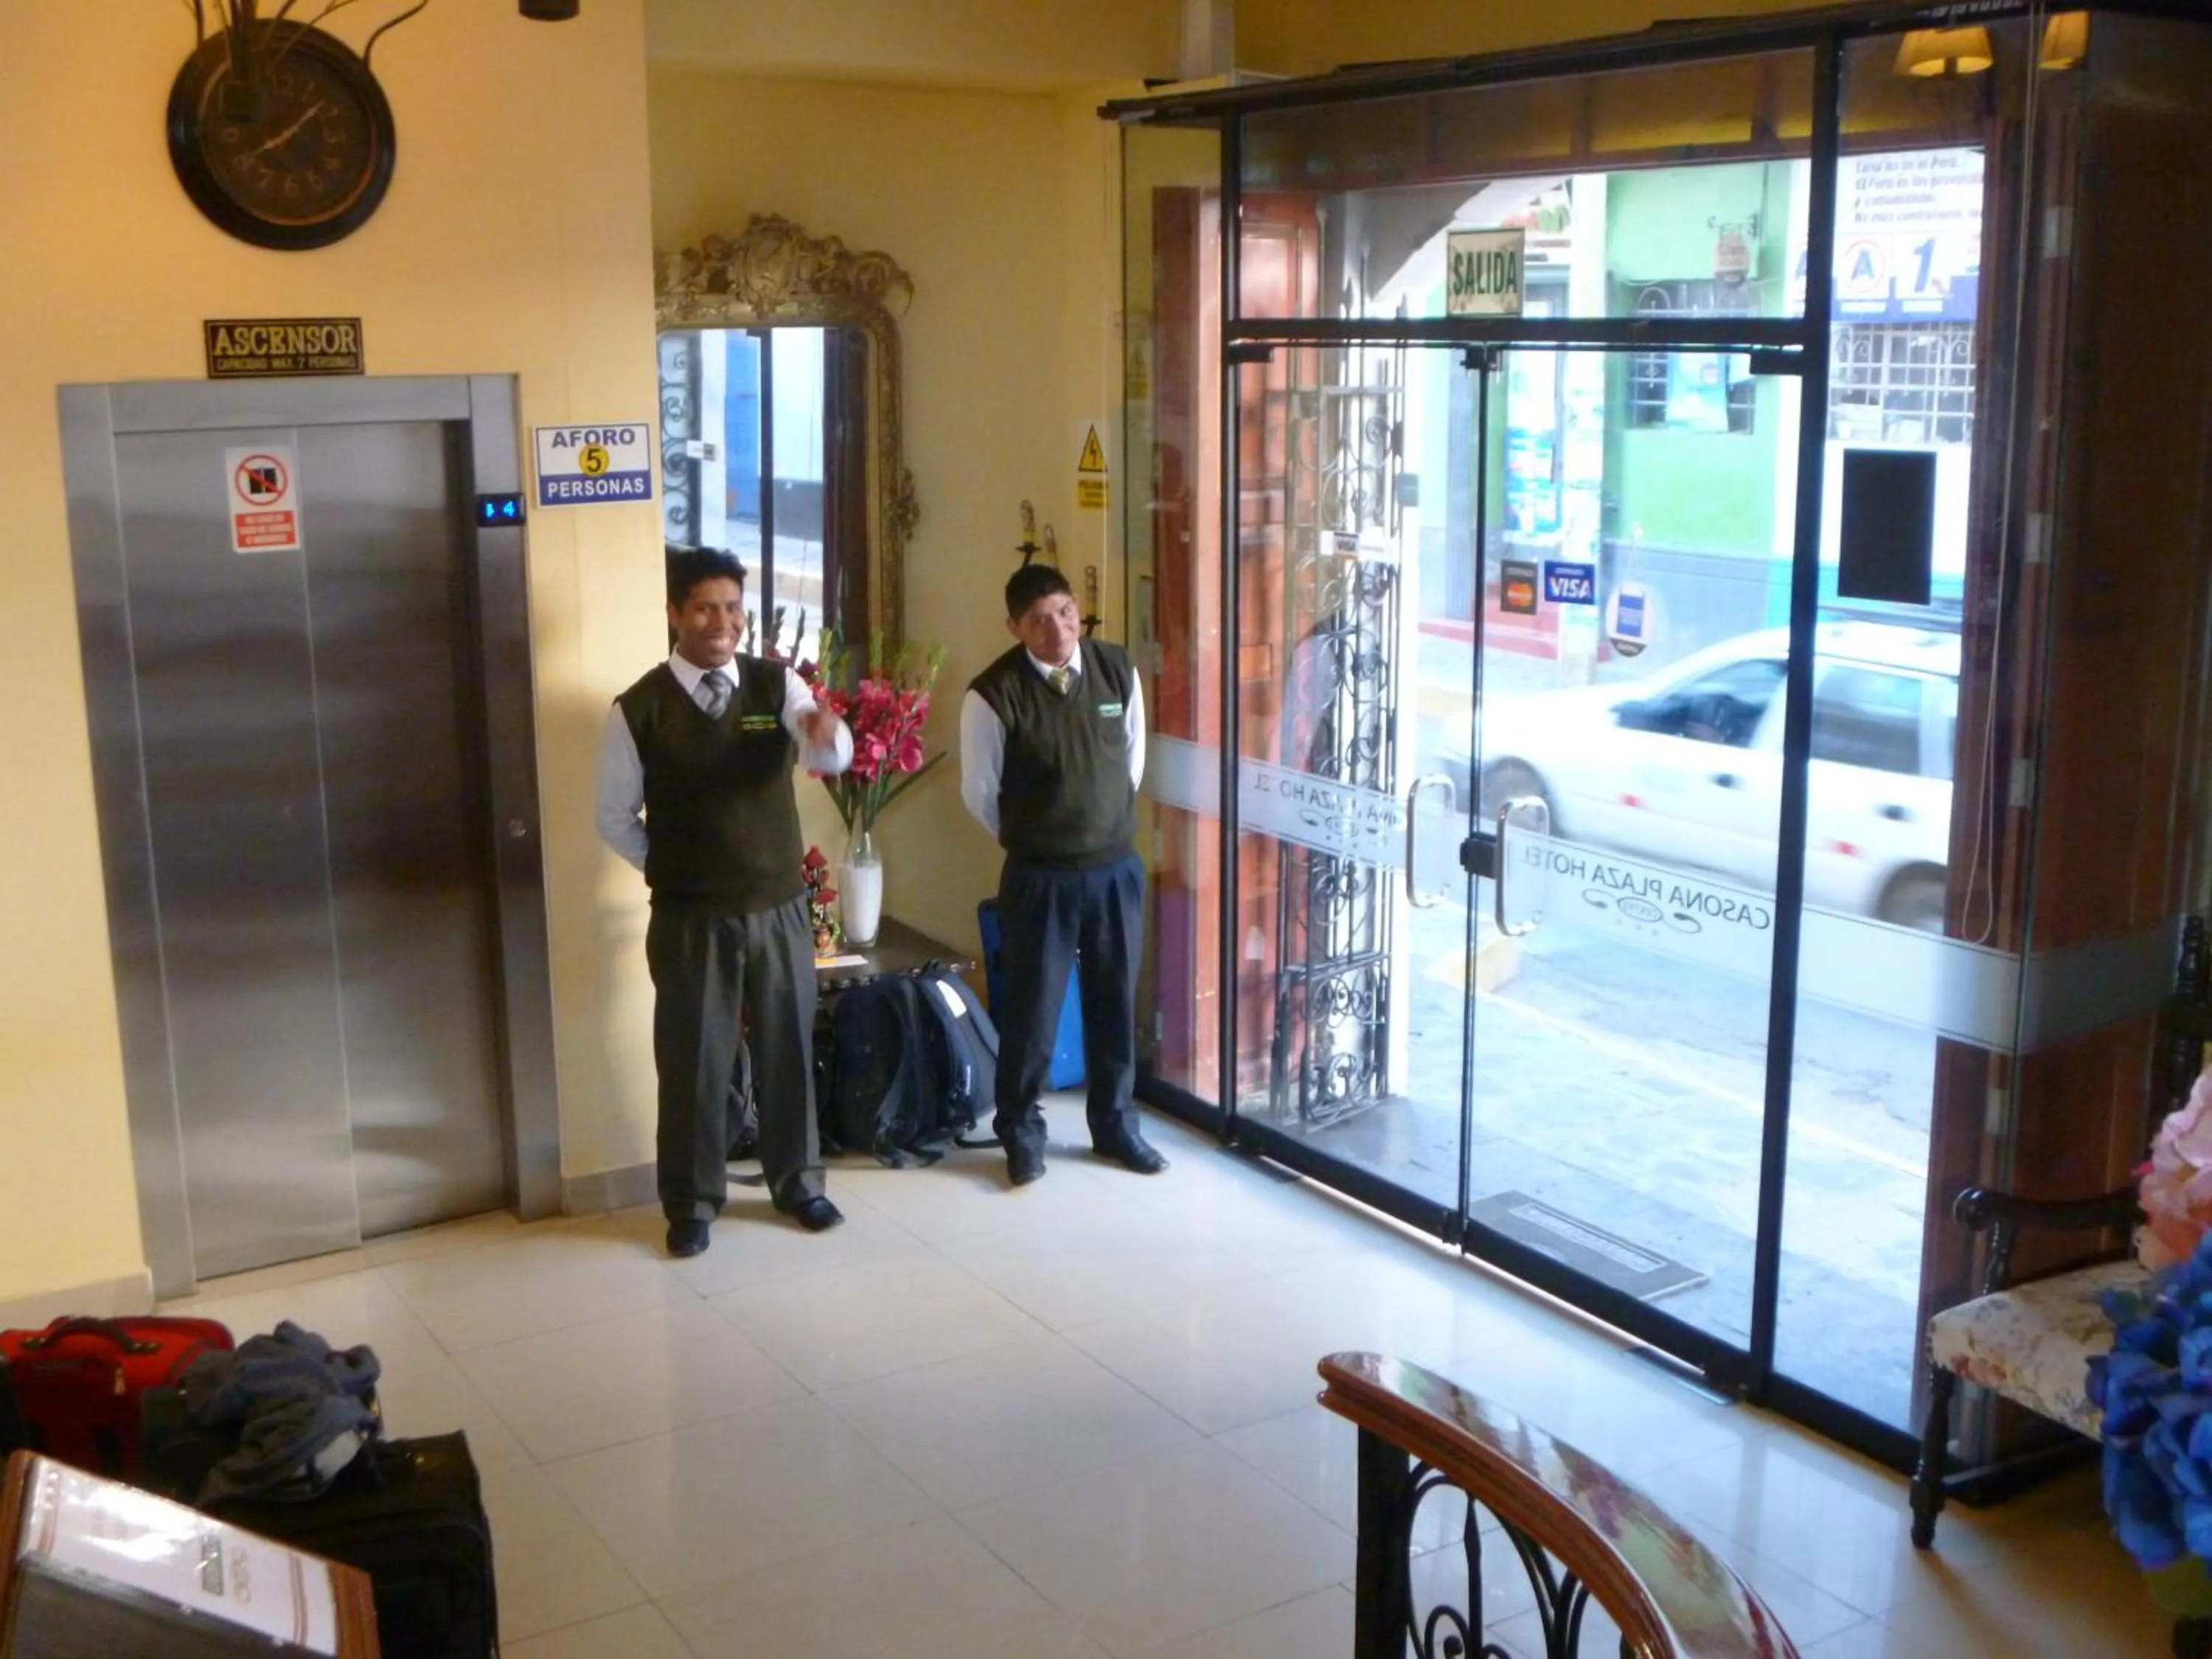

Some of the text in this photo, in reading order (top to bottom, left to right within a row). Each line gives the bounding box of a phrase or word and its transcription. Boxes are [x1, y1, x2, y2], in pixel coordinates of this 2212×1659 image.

[1453, 251, 1518, 296] SALIDA
[1851, 249, 1875, 282] A
[1913, 237, 1936, 293] 1
[214, 324, 358, 356] ASCENSOR
[552, 428, 636, 448] AFORO
[587, 448, 602, 473] 5
[548, 478, 645, 499] PERSONAS
[1550, 576, 1591, 599] VISA
